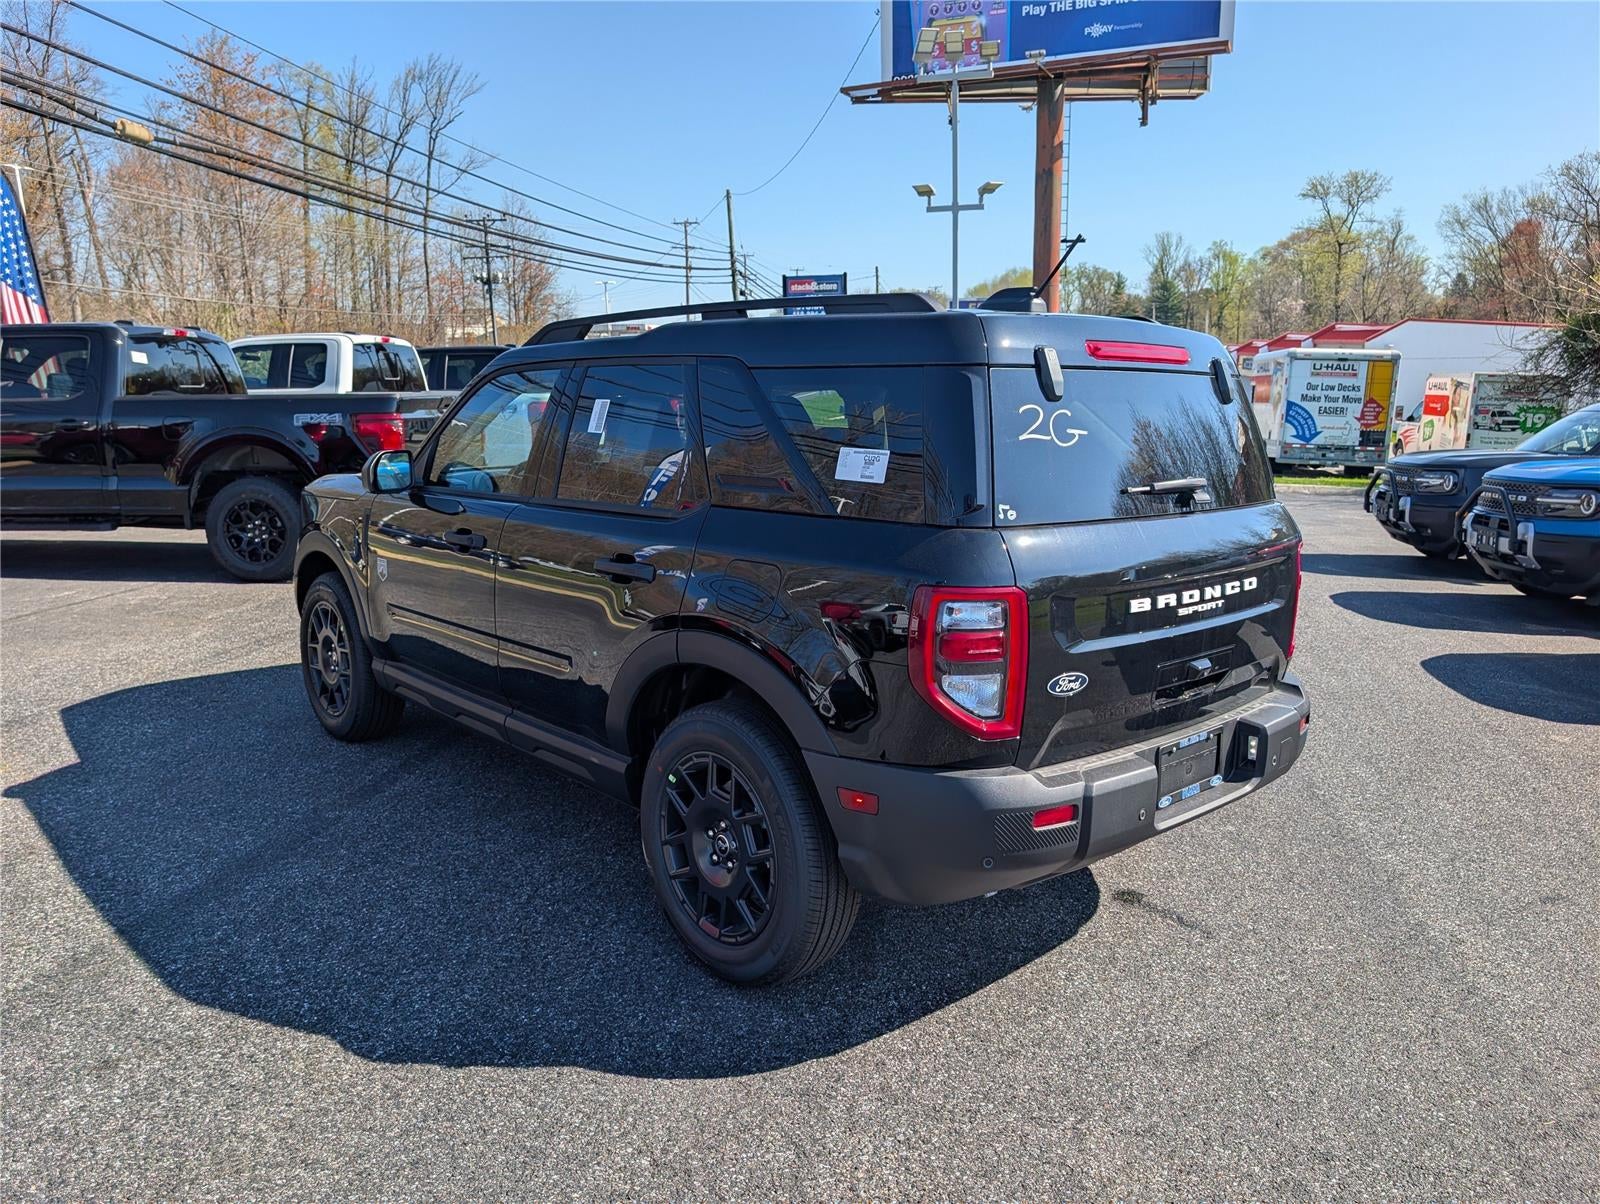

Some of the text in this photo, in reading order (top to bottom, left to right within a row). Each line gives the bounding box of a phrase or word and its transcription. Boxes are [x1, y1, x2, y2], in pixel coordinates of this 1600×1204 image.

[1022, 4, 1047, 16] Play
[1049, 1, 1073, 13] THE
[1075, 0, 1097, 9] BIG
[1312, 363, 1358, 371] U-HAUL
[1306, 382, 1361, 392] Our Low Decks
[1300, 393, 1362, 404] Make Your Move
[1318, 406, 1348, 415] EASIER!
[294, 412, 342, 426] FX4
[1018, 404, 1088, 447] 2G
[1129, 576, 1258, 614] BRONCO
[1176, 599, 1225, 617] SPORT
[1056, 676, 1081, 692] Ford
